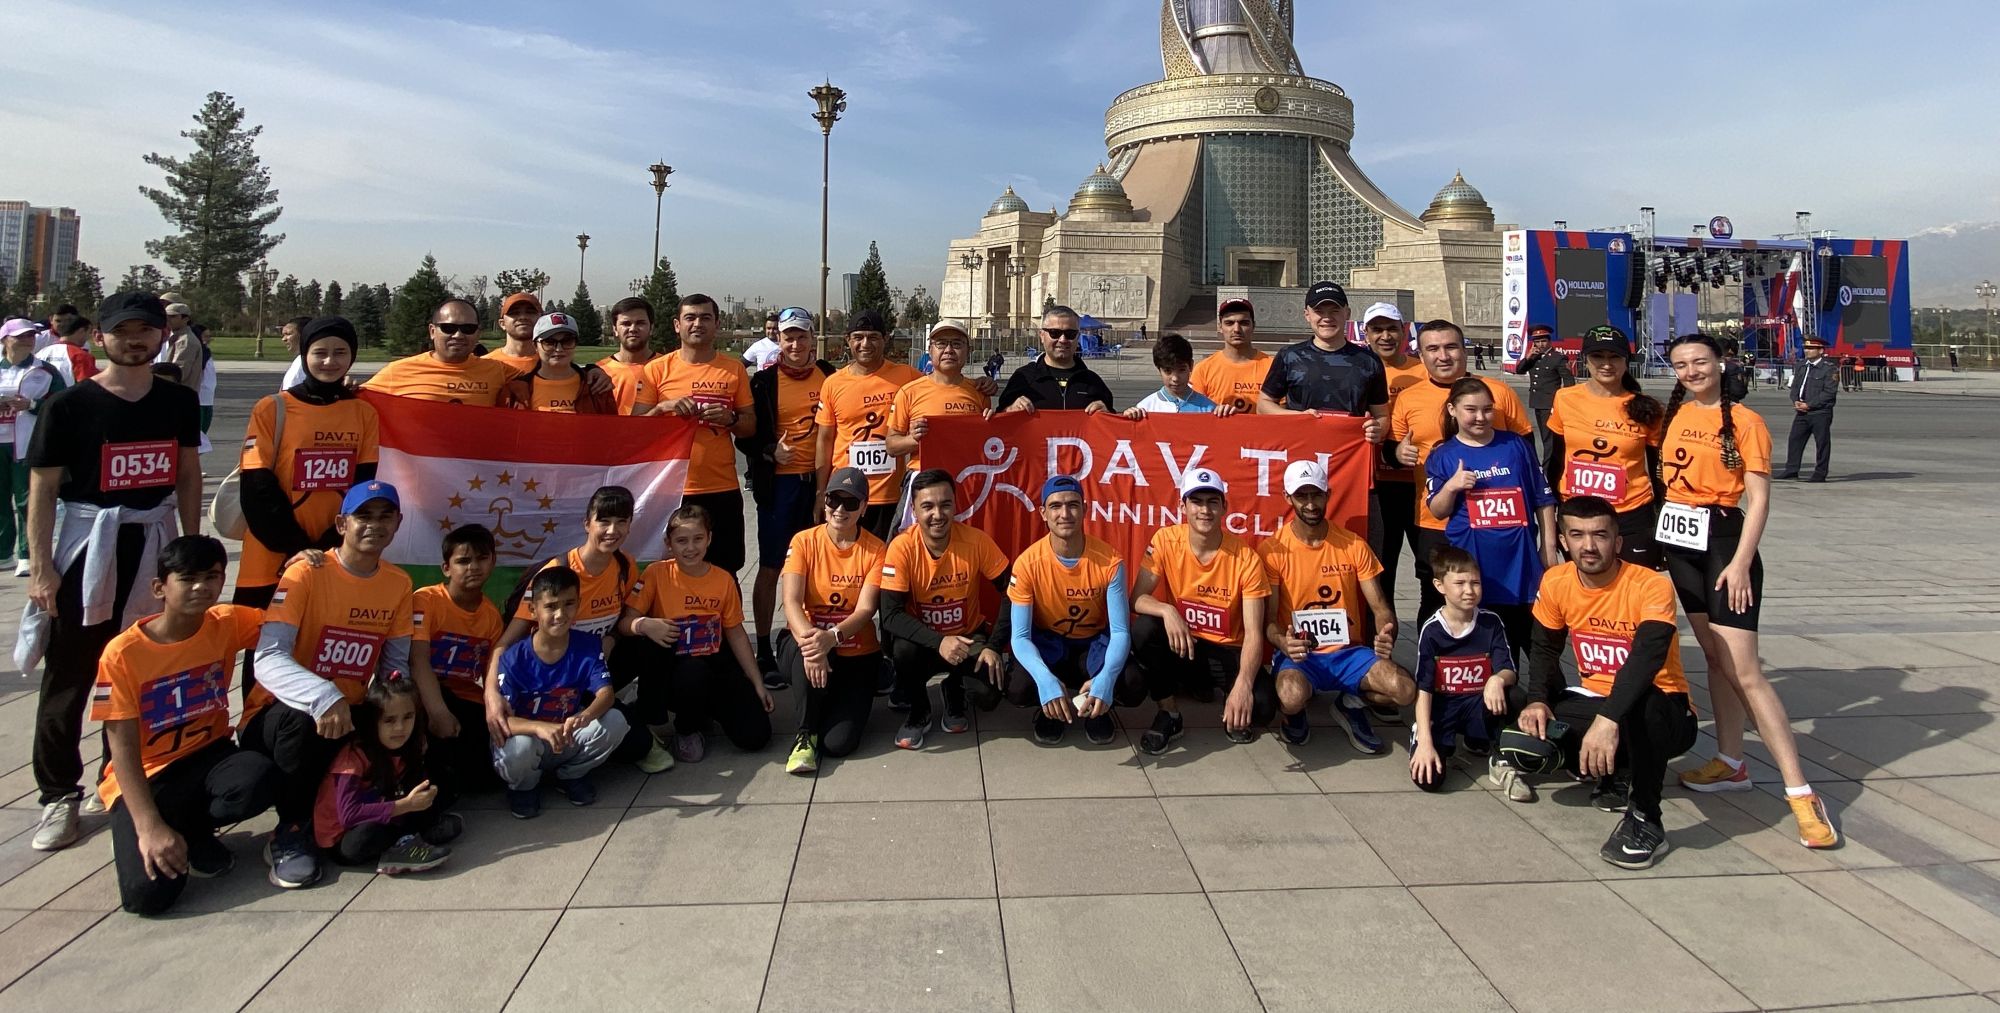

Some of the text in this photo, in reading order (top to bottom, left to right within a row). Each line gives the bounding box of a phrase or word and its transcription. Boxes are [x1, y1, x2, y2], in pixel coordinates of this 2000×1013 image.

[1568, 281, 1605, 290] HOLLYLAND
[1852, 287, 1886, 296] HOLLYLAND
[692, 381, 729, 390] DAV.TJ
[863, 392, 895, 404] DAV.T
[1595, 420, 1641, 434] DAV.TJ
[314, 431, 360, 442] DAV.TJ
[111, 452, 171, 477] 0534
[856, 449, 889, 466] 0167
[304, 458, 349, 480] 1248
[1474, 466, 1511, 480] One Run
[109, 479, 118, 487] 10
[300, 480, 306, 489] 5
[1574, 468, 1616, 492] 1078
[1476, 498, 1516, 518] 1241
[1475, 518, 1481, 526] 5
[1662, 512, 1699, 537] 0165
[1321, 563, 1352, 574] DAV.TJ
[930, 571, 968, 586] DAV.TJ
[1197, 584, 1232, 597] DAV.TJ
[349, 607, 396, 620] DAV.TJ
[921, 607, 963, 625] 3059
[1185, 607, 1221, 629] 0511
[1300, 618, 1342, 636] 0164
[1588, 617, 1637, 632] DAV.TJ
[684, 627, 692, 645] 1
[318, 638, 374, 667] 3600
[447, 645, 459, 665] 1
[1579, 641, 1629, 666] 0470
[315, 663, 322, 673] 5
[1583, 662, 1592, 670] 10
[1443, 664, 1484, 684] 1242
[172, 685, 183, 709] 1
[532, 696, 542, 714] 1
